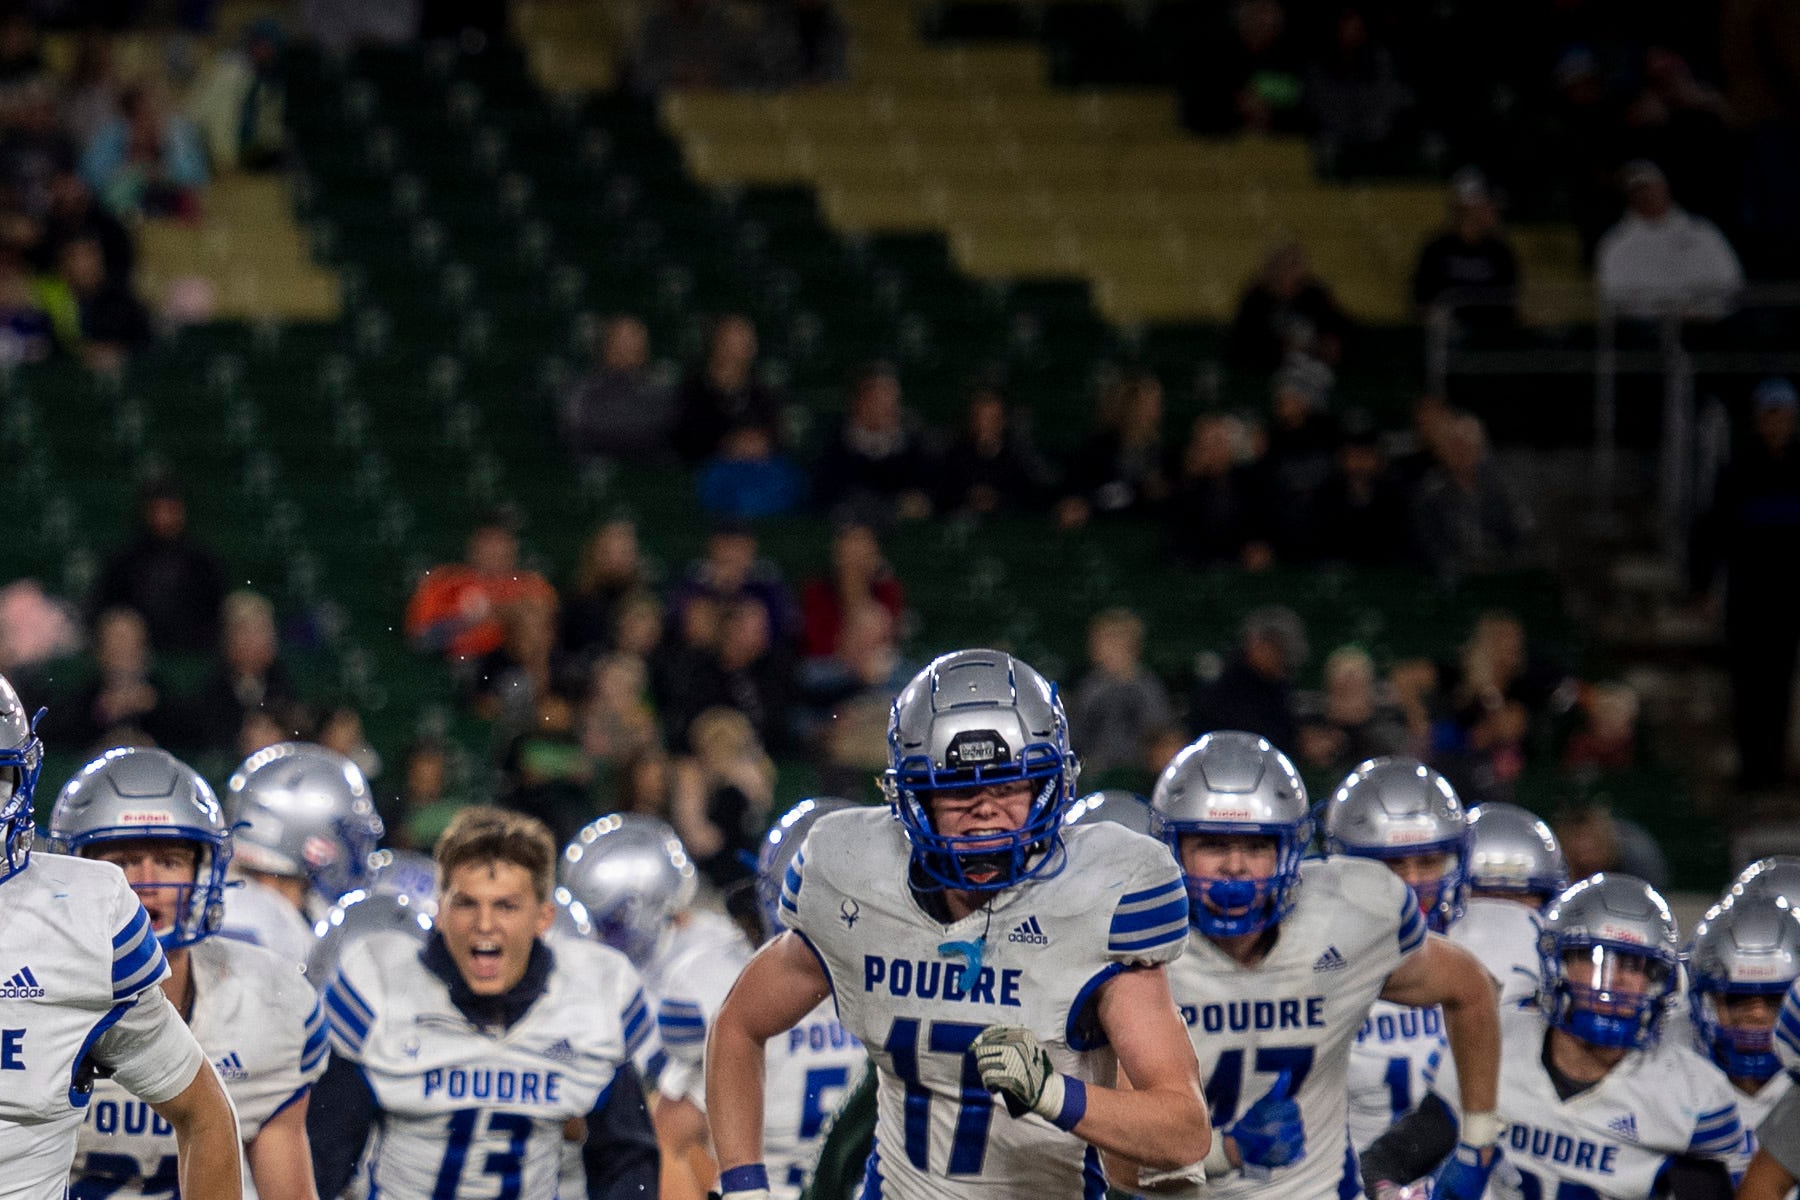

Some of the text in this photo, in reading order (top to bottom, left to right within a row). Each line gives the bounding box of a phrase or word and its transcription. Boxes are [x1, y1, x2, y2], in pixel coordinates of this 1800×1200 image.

[1007, 932, 1049, 946] adidas
[864, 954, 1024, 1007] POUDRE
[424, 1067, 565, 1104] POUDRE
[883, 1016, 997, 1178] 17
[1501, 1122, 1620, 1175] OUDRE
